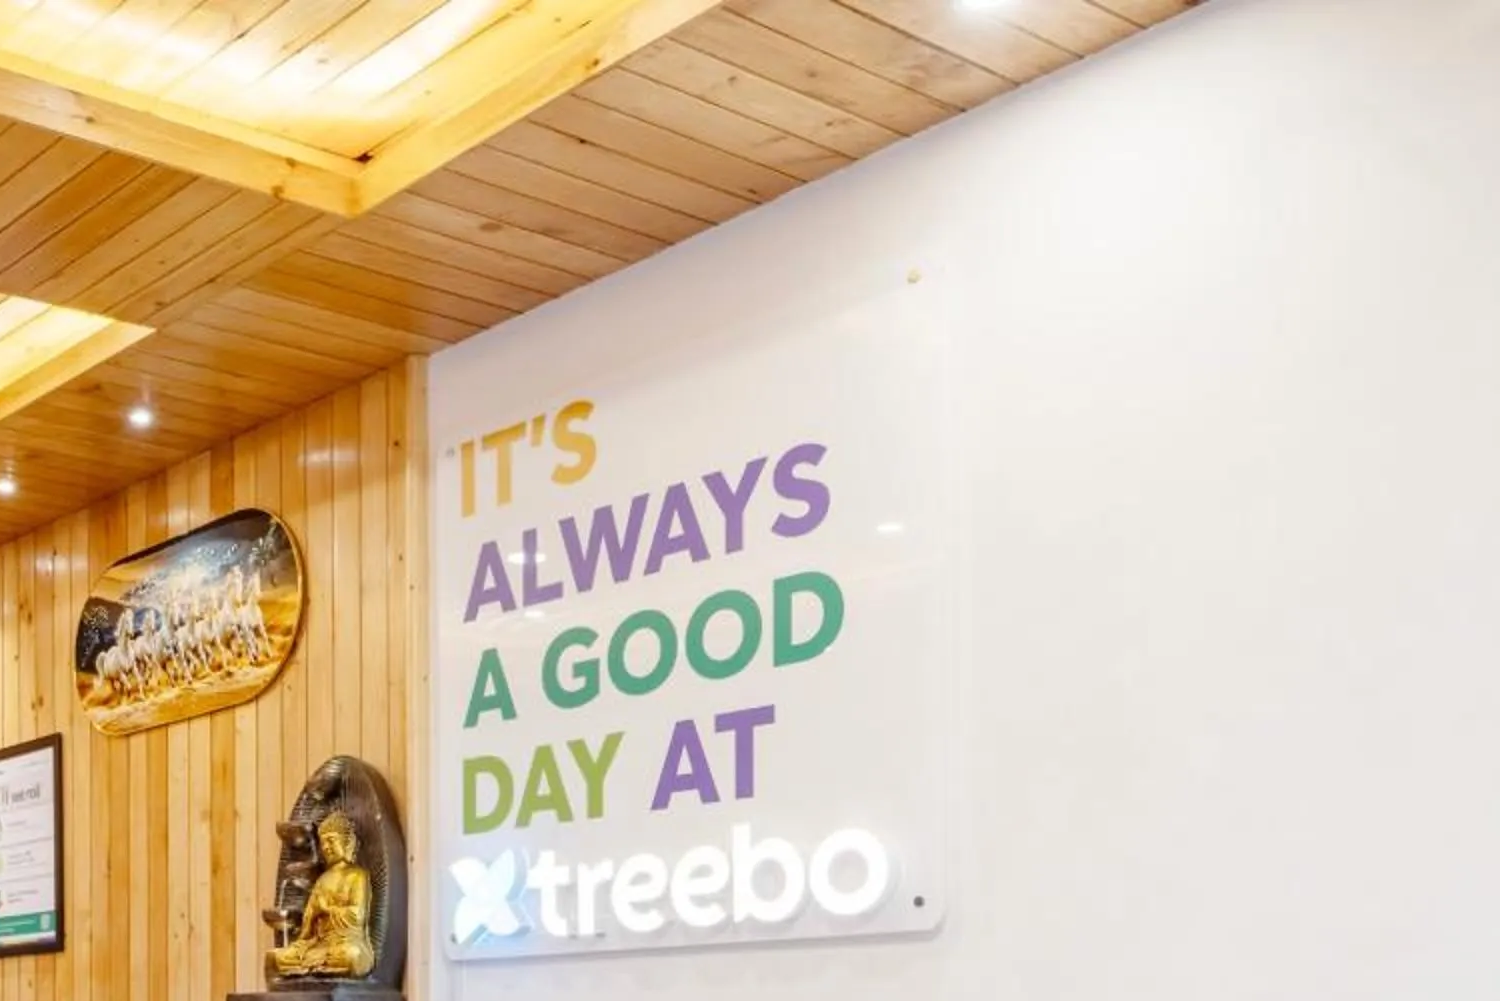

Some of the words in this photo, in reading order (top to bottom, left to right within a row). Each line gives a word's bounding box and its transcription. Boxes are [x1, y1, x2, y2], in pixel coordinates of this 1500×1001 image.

[459, 399, 598, 518] IT'S
[463, 442, 831, 623] ALWAYS
[463, 647, 517, 729] A
[541, 571, 845, 709] GOOD
[462, 731, 625, 835] DAY
[650, 704, 775, 811] AT
[528, 822, 889, 938] treebo
